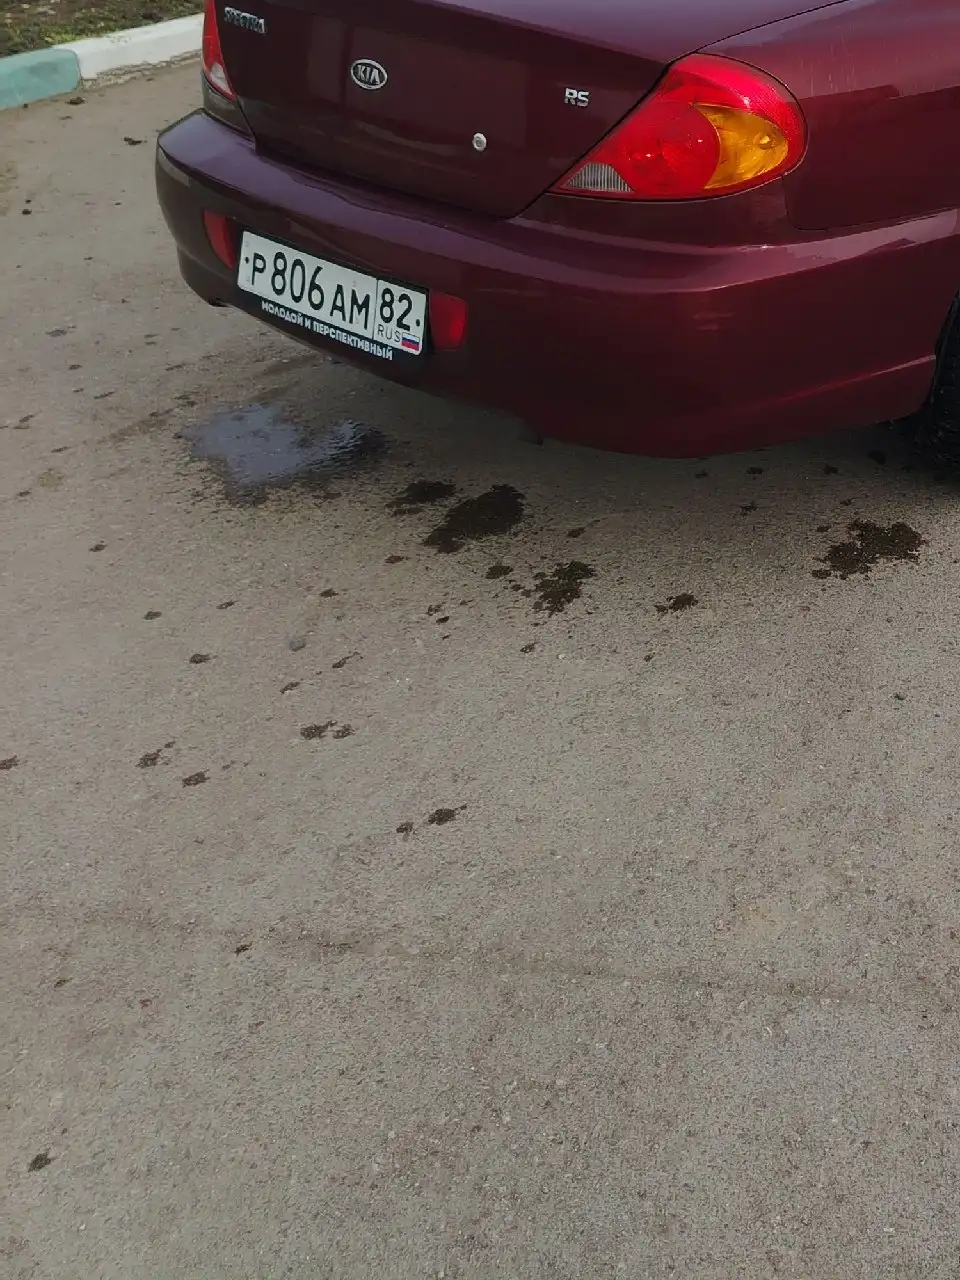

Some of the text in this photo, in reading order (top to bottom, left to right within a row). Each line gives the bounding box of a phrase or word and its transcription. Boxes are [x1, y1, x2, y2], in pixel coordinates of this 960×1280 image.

[357, 64, 381, 85] KIA
[564, 87, 589, 107] RS
[379, 287, 412, 331] 82
[261, 300, 393, 361] МОЛОДОЙ И ПЕРСПЕКТИВНЫЙ
[377, 323, 401, 343] RUS
